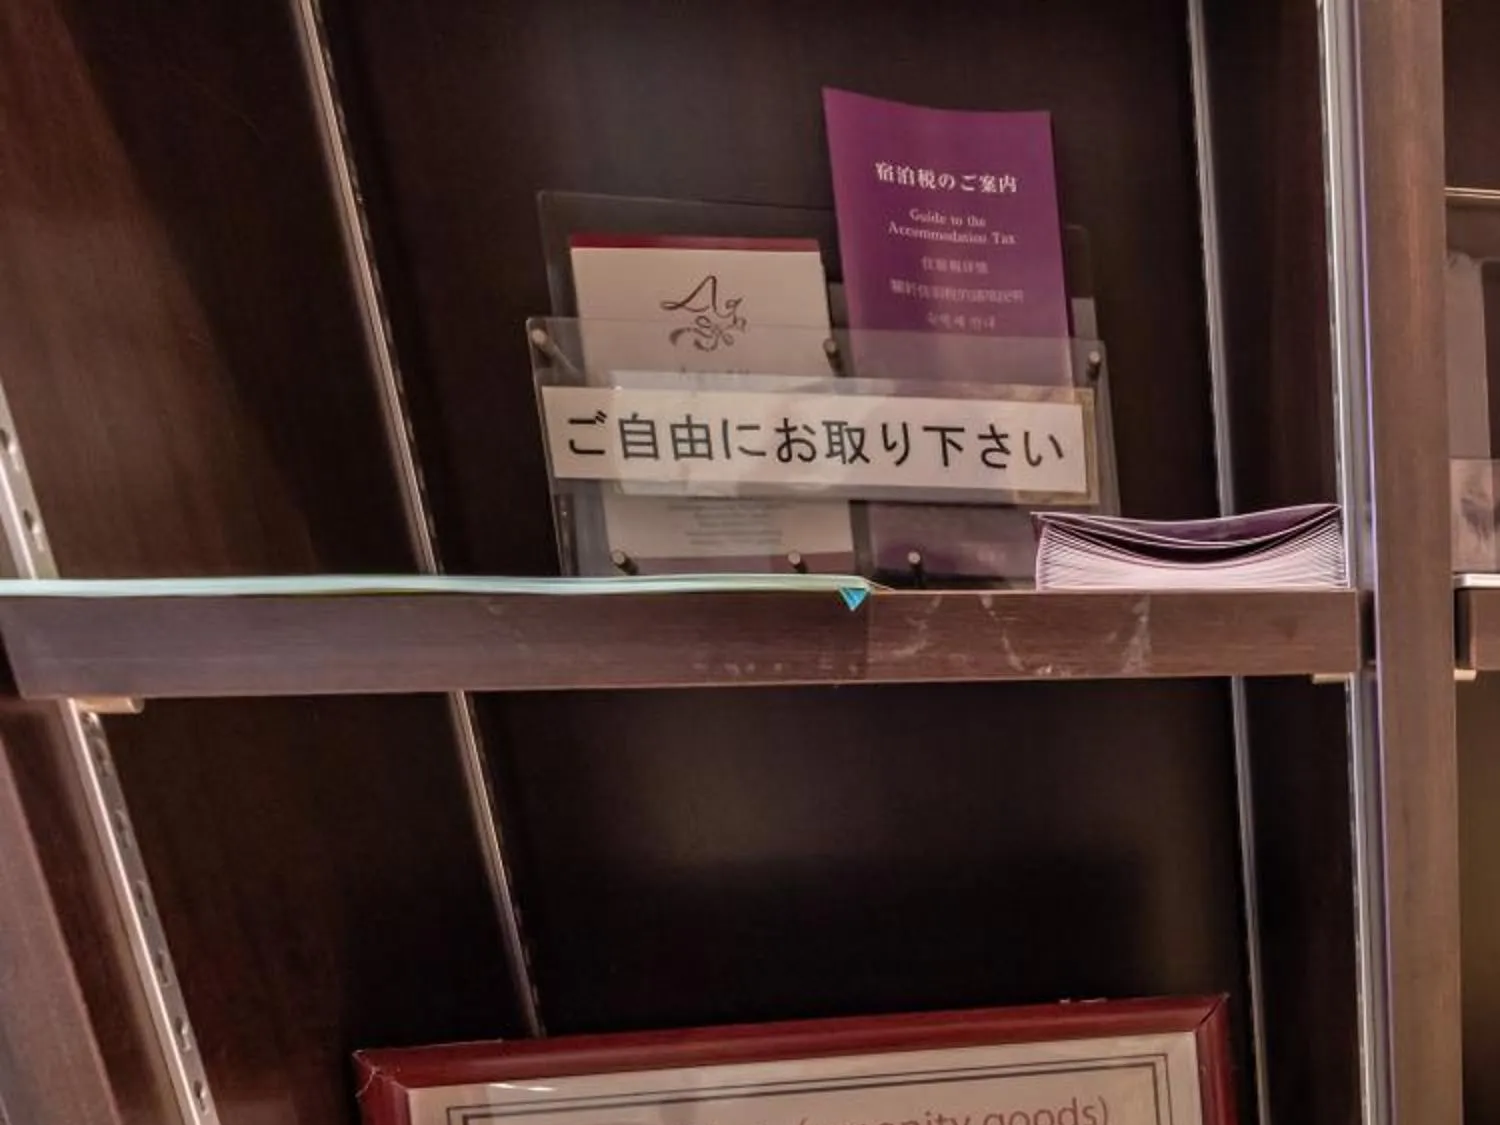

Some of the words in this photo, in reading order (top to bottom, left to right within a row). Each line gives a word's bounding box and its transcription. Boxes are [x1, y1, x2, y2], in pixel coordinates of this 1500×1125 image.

[908, 208, 947, 224] Guide
[950, 215, 963, 226] to
[967, 214, 986, 227] the
[992, 232, 1016, 245] Tax
[567, 410, 1064, 469] ご自由にお取り下さい
